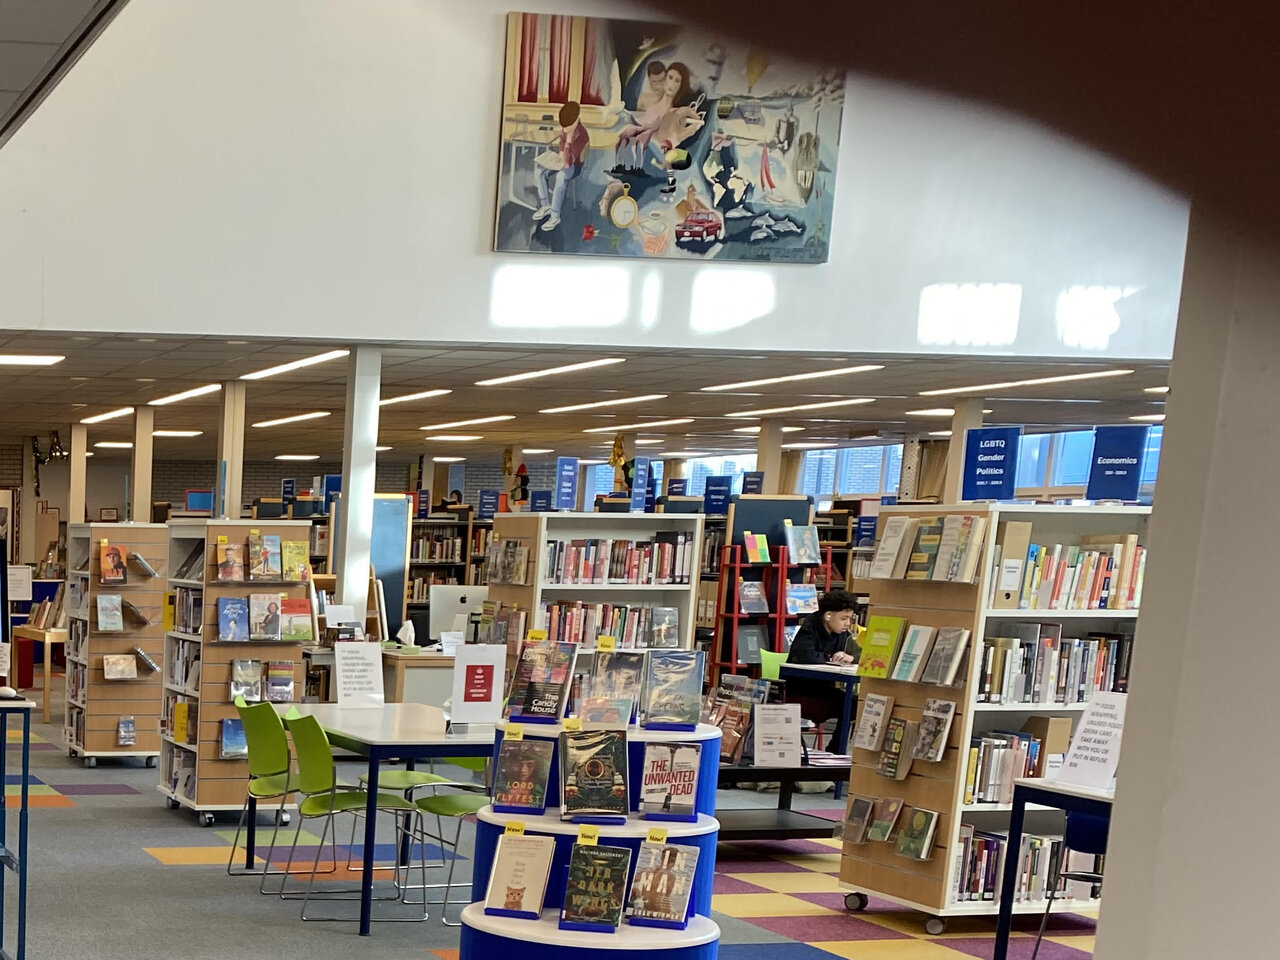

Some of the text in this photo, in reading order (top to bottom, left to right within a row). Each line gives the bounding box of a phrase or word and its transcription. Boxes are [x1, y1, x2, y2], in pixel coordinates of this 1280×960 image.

[979, 439, 1006, 448] LGBTQ
[977, 453, 1005, 462] Gender
[1097, 456, 1138, 465] Economics
[976, 467, 1004, 475] Politics
[532, 699, 558, 708] Candy
[530, 706, 557, 714] House
[1089, 755, 1108, 764] REFUSE
[650, 759, 669, 773] THE
[644, 770, 696, 786] UNWANTED
[507, 781, 534, 790] LORD
[669, 782, 694, 796] DEAD
[649, 848, 688, 871] TIN
[578, 880, 615, 894] DARK
[639, 871, 687, 895] MAN
